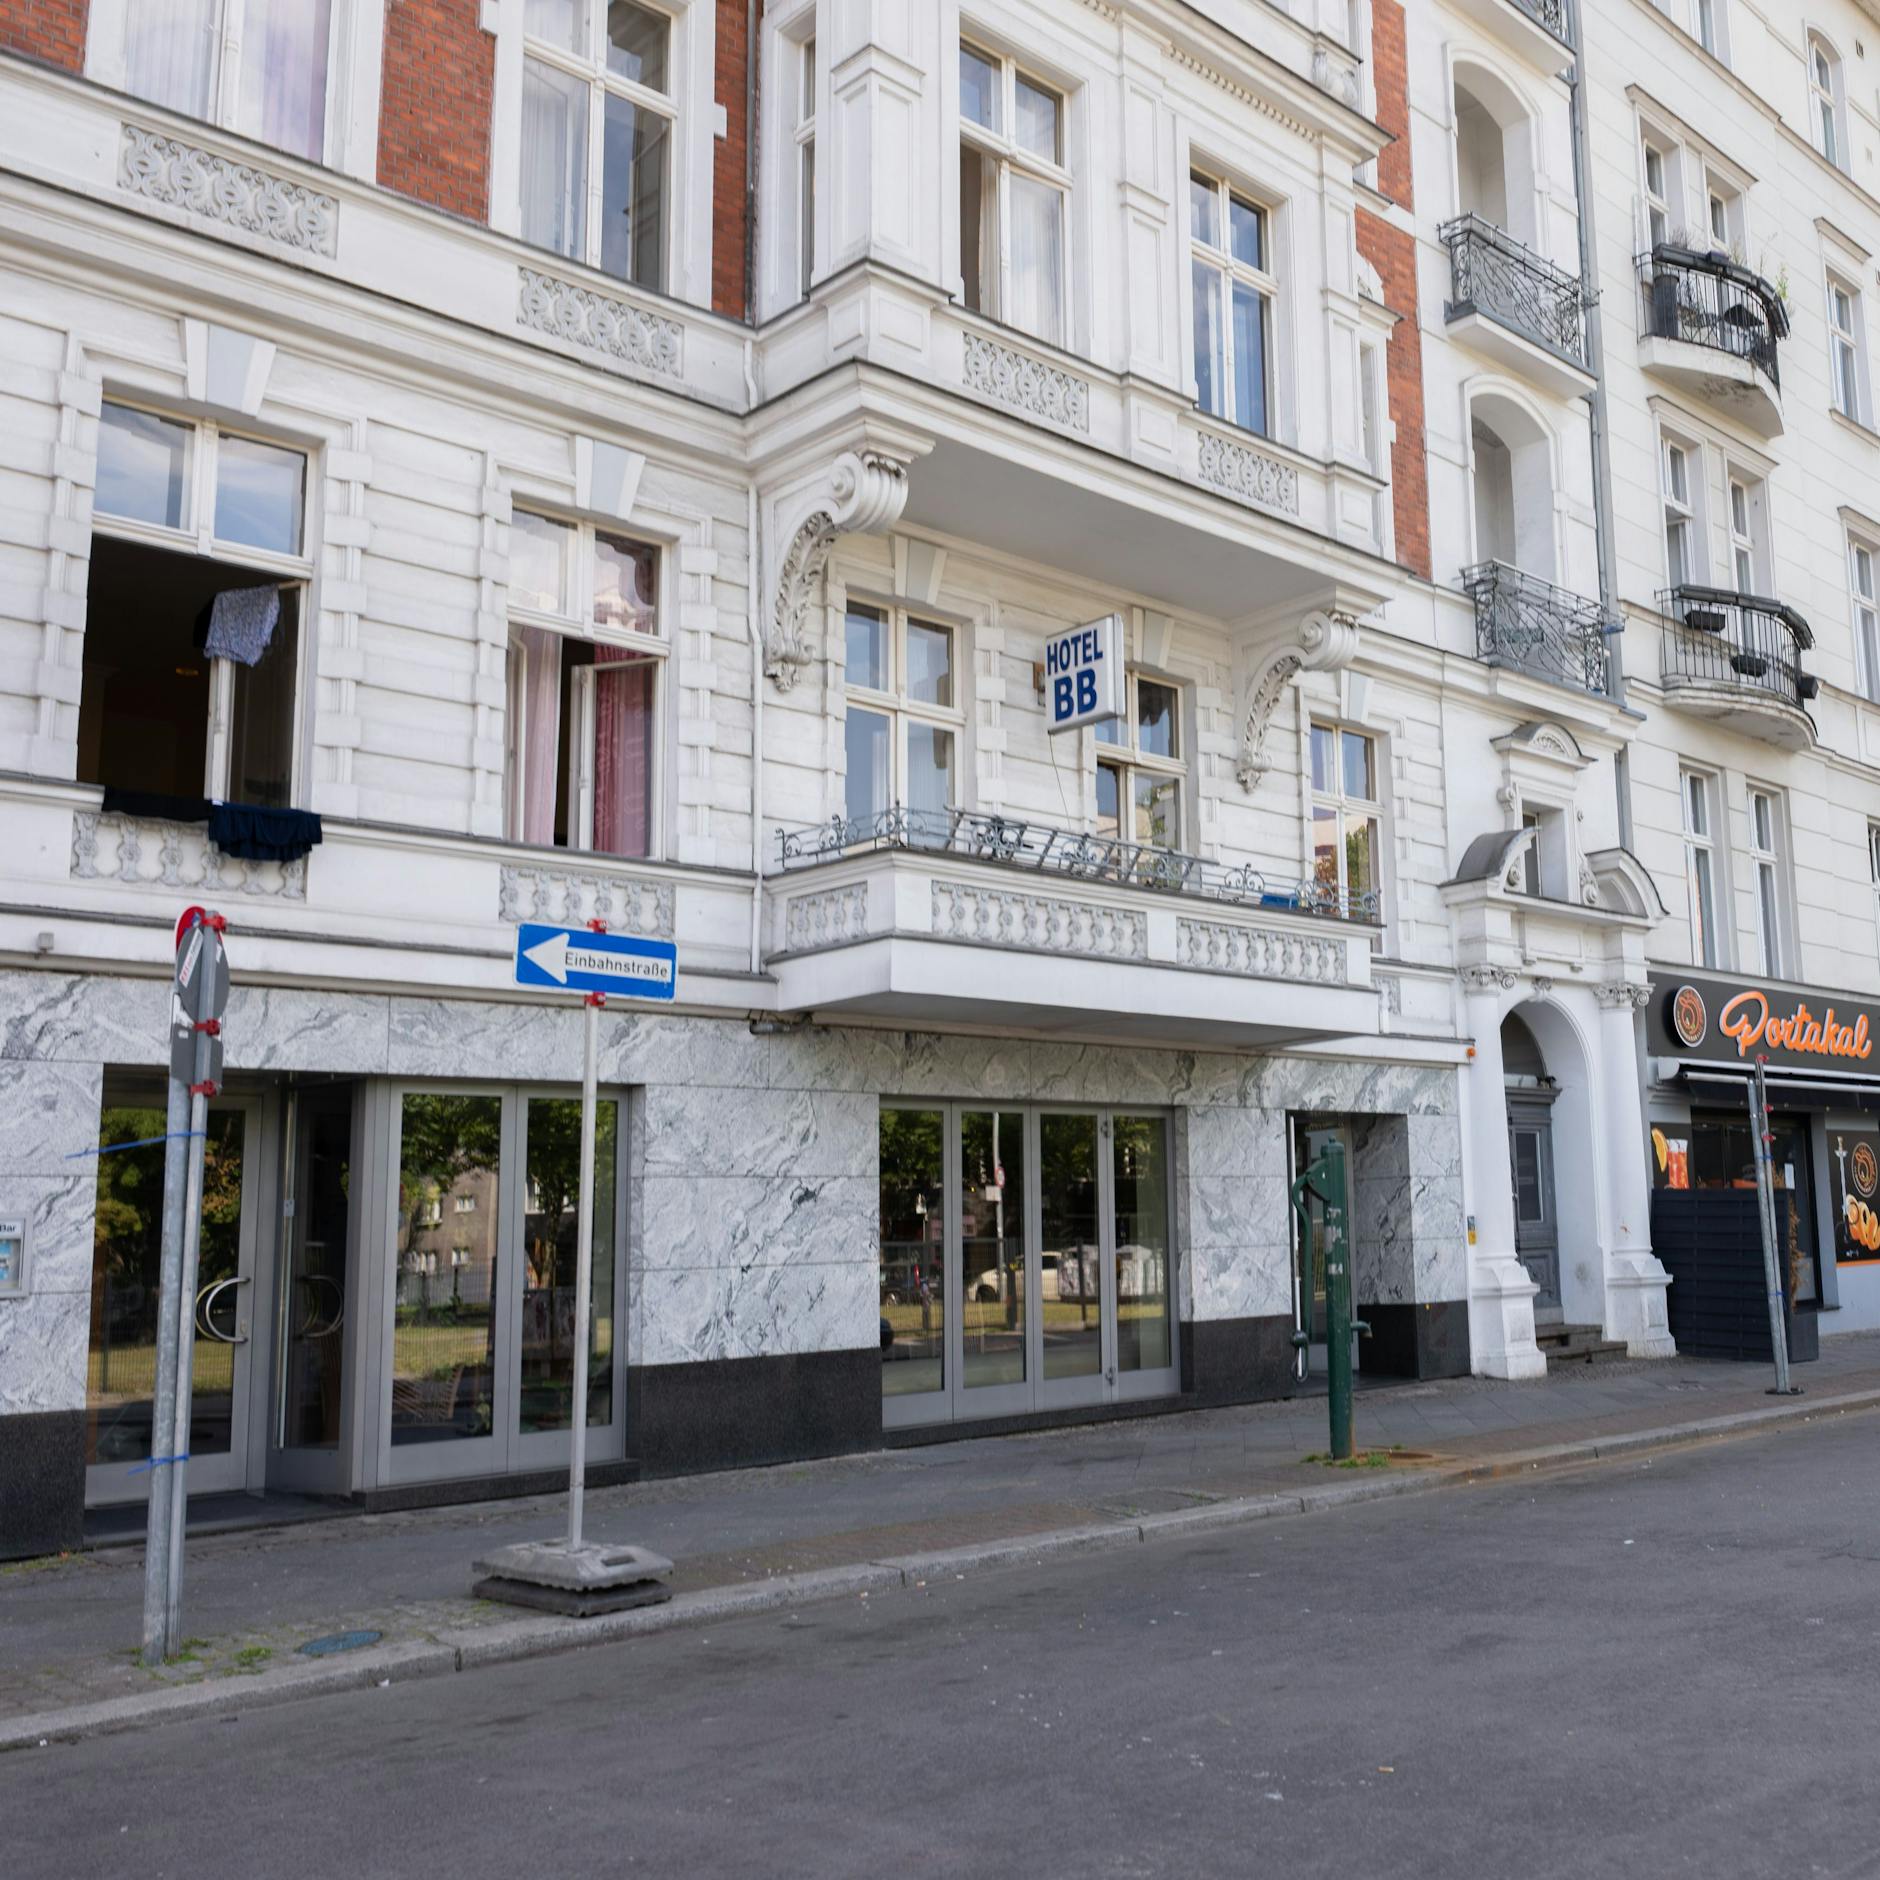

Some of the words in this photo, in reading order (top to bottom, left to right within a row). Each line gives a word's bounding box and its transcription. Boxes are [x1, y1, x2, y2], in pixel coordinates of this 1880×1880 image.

[1046, 628, 1103, 676] HOTEL
[1054, 668, 1097, 722] BB
[564, 951, 668, 978] Einbahnstraße
[1718, 990, 1873, 1060] Portakal
